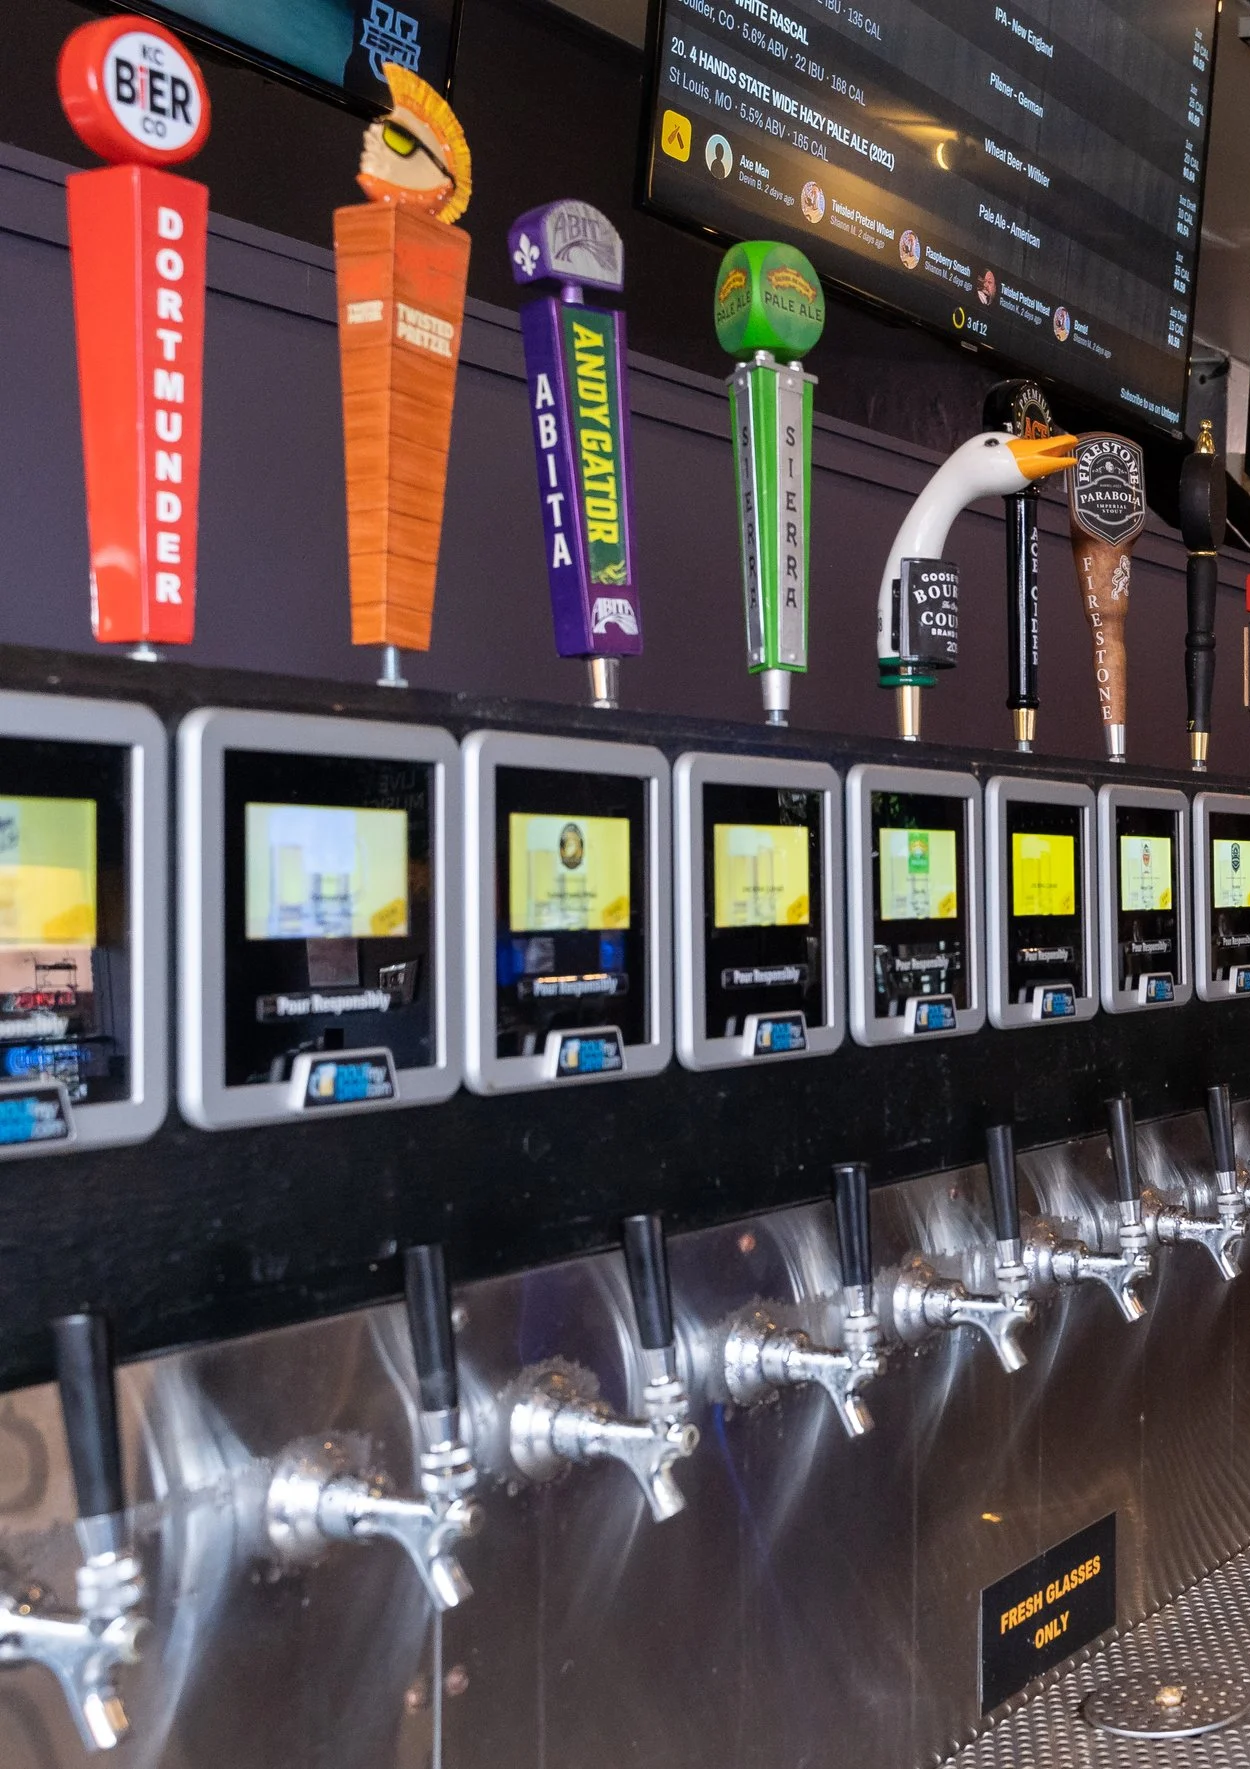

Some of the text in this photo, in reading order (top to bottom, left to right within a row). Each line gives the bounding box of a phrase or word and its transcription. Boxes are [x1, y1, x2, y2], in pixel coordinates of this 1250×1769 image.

[769, 10, 810, 46] RASCAL
[848, 7, 863, 28] 135
[864, 18, 883, 41] CAL
[995, 6, 1053, 58] IPA New England
[141, 42, 166, 66] KC
[718, 9, 866, 107] CO 5.6% ABV 22 IBU 168 CAL
[671, 36, 895, 172] 20. 4 HANDS STATE WIDE HAZY PALE ALE (2021)
[990, 72, 1044, 118] Pilsner German
[141, 116, 167, 139] CO
[669, 66, 829, 162] St Louis, MO 5.5% ABV 165 CAL
[740, 154, 770, 180] Axe Man
[984, 138, 1050, 188] Wheat Beer Witbier
[738, 171, 795, 206] Devin B. 2 days ago
[831, 199, 895, 240] Twisted Pretzel Wheat
[979, 204, 1040, 250] Pale Ale American
[1184, 212, 1194, 226] CAL
[925, 246, 971, 278] Raspberry Smash
[1181, 269, 1190, 282] CAL
[396, 302, 454, 341] TWISTED
[764, 291, 823, 322] PALE ALE
[396, 321, 453, 358] PRETZEL
[967, 317, 988, 337] 3 of 12
[1175, 324, 1184, 337] CAL
[153, 205, 185, 605] DORTMUNDER
[1020, 388, 1051, 422] PREMIUM
[1120, 387, 1144, 408] Subscribe
[572, 321, 619, 545] ANDY GATOR
[534, 372, 573, 569] ABITA
[1079, 442, 1140, 484] FIRESTONE
[1080, 492, 1141, 507] PARABOLA
[740, 425, 759, 610] SIERRA
[786, 425, 798, 610] SIERRA
[921, 572, 955, 582] GOOSE
[592, 597, 636, 621] ABITA
[1082, 556, 1113, 720] FIRESTONE
[895, 954, 950, 972] Pour Responsibly
[1024, 948, 1069, 962] Pour Responsibly
[1132, 940, 1168, 954] Pour Responsibly
[733, 966, 800, 986] Pour Responsibly
[276, 990, 392, 1017] Pour Responsibly
[1000, 1555, 1101, 1634] FRESH GLASSES
[1034, 1611, 1070, 1650] ONLY
